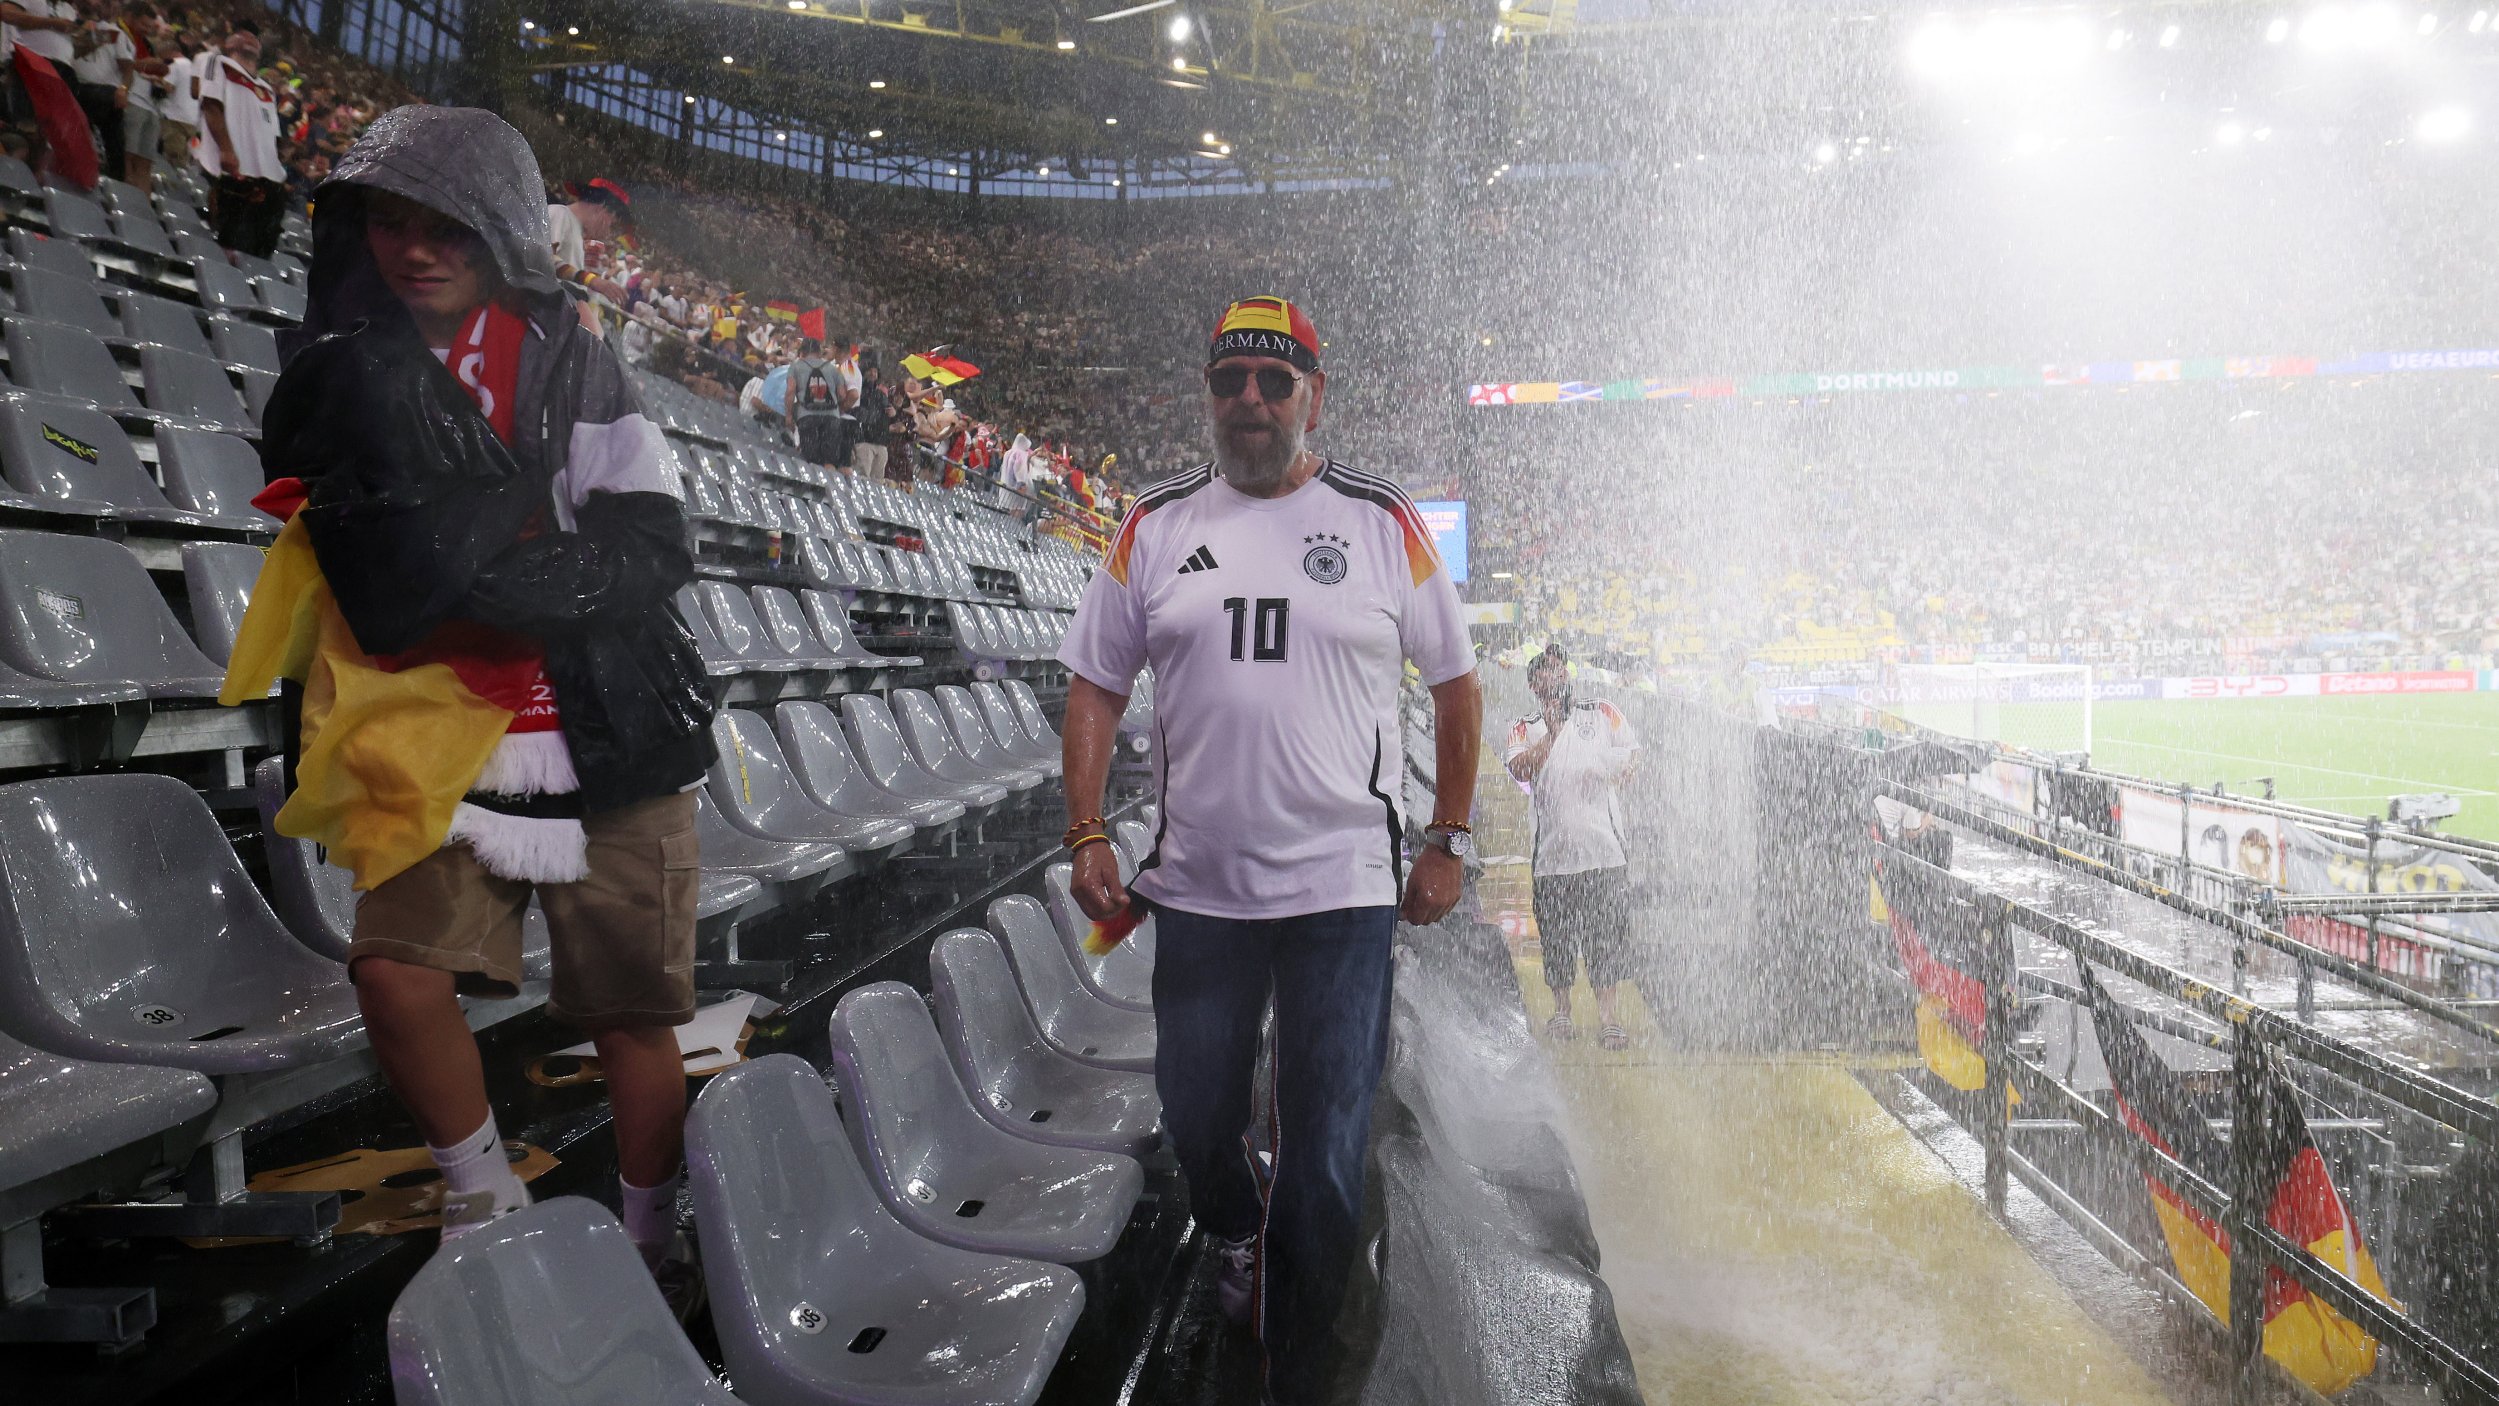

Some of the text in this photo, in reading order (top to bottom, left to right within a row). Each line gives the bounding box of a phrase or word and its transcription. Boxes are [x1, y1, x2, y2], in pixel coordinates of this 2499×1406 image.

[1212, 333, 1297, 356] GERMANY
[1817, 369, 1959, 391] DORTMUND
[1223, 597, 1291, 663] 10
[2140, 637, 2222, 657] TEMPLIN
[1859, 686, 1921, 704] QATAR
[1931, 684, 2009, 701] AIRWAYS
[2029, 681, 2144, 698] Booking.com
[2191, 674, 2289, 697] BYD
[143, 1009, 175, 1025] 38
